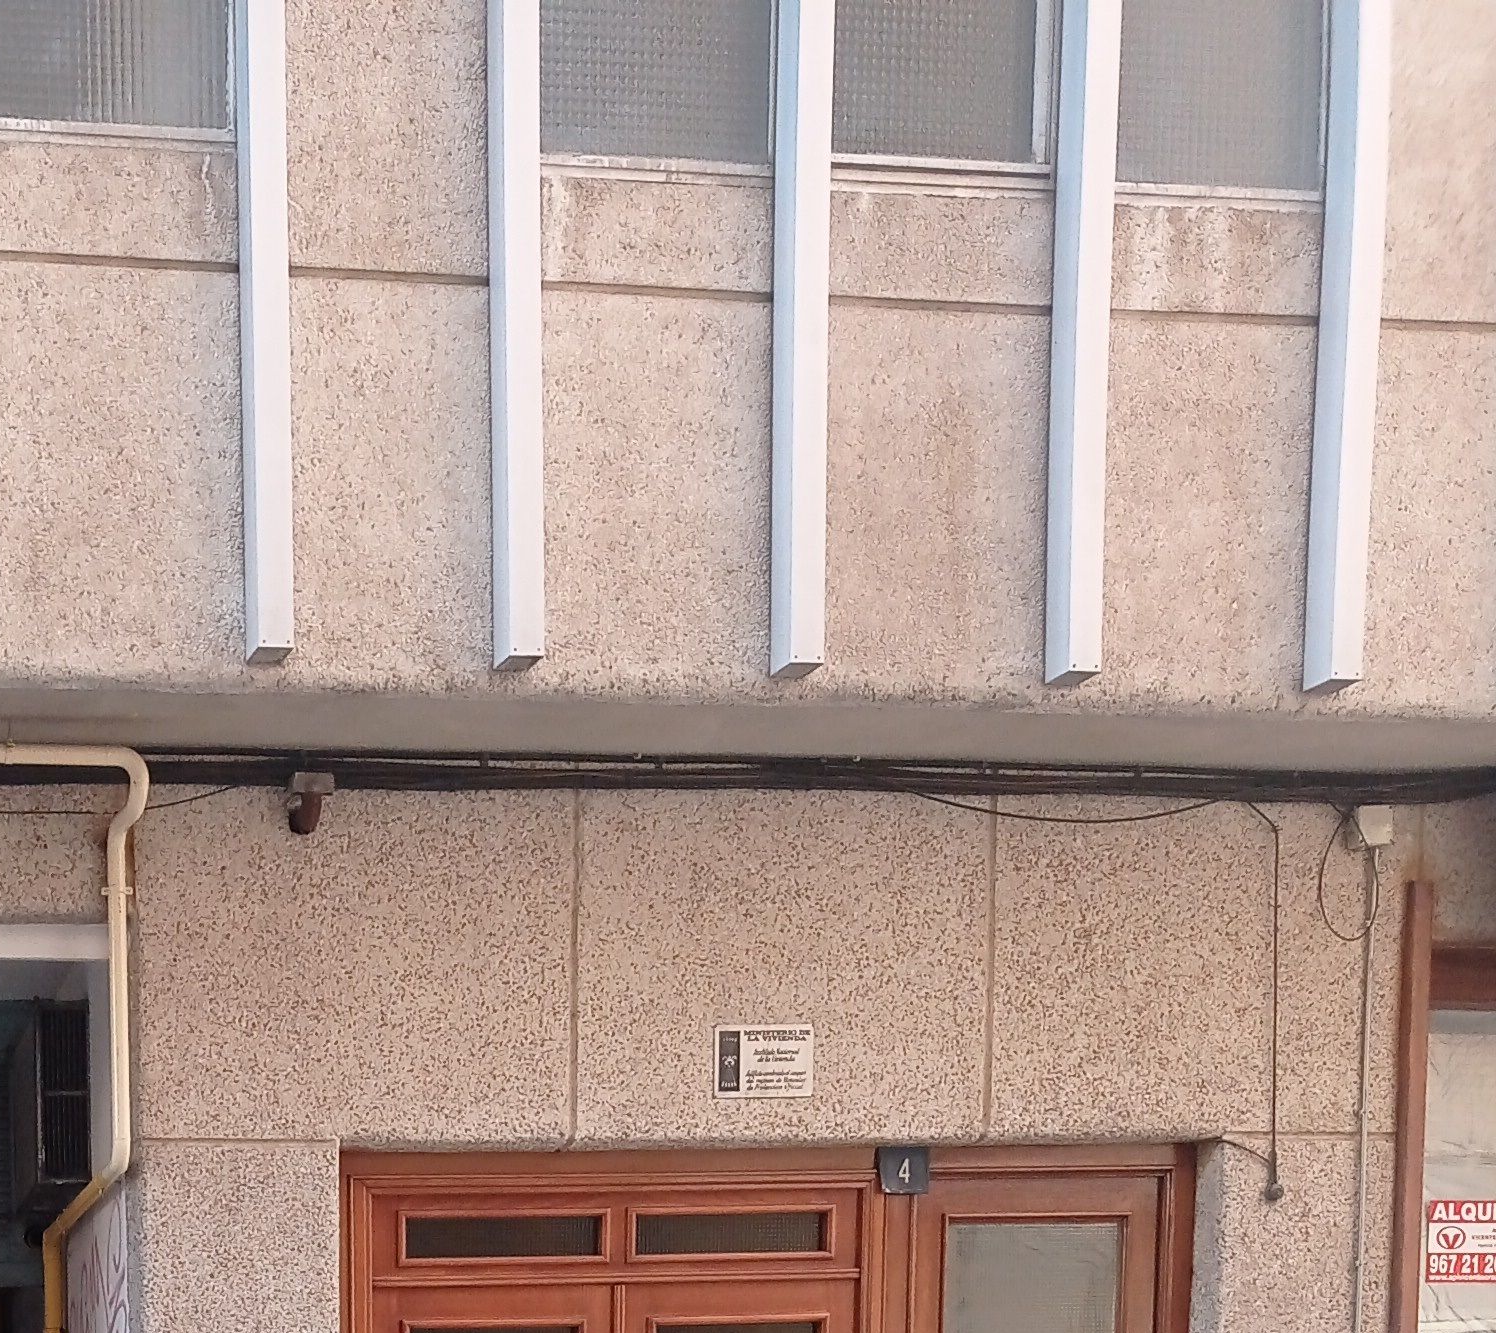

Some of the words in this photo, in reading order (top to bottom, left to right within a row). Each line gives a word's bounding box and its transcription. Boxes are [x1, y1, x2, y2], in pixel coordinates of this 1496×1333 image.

[897, 1157, 910, 1184] 4
[1429, 1254, 1457, 1274] 967
[1461, 1254, 1479, 1274] 21
